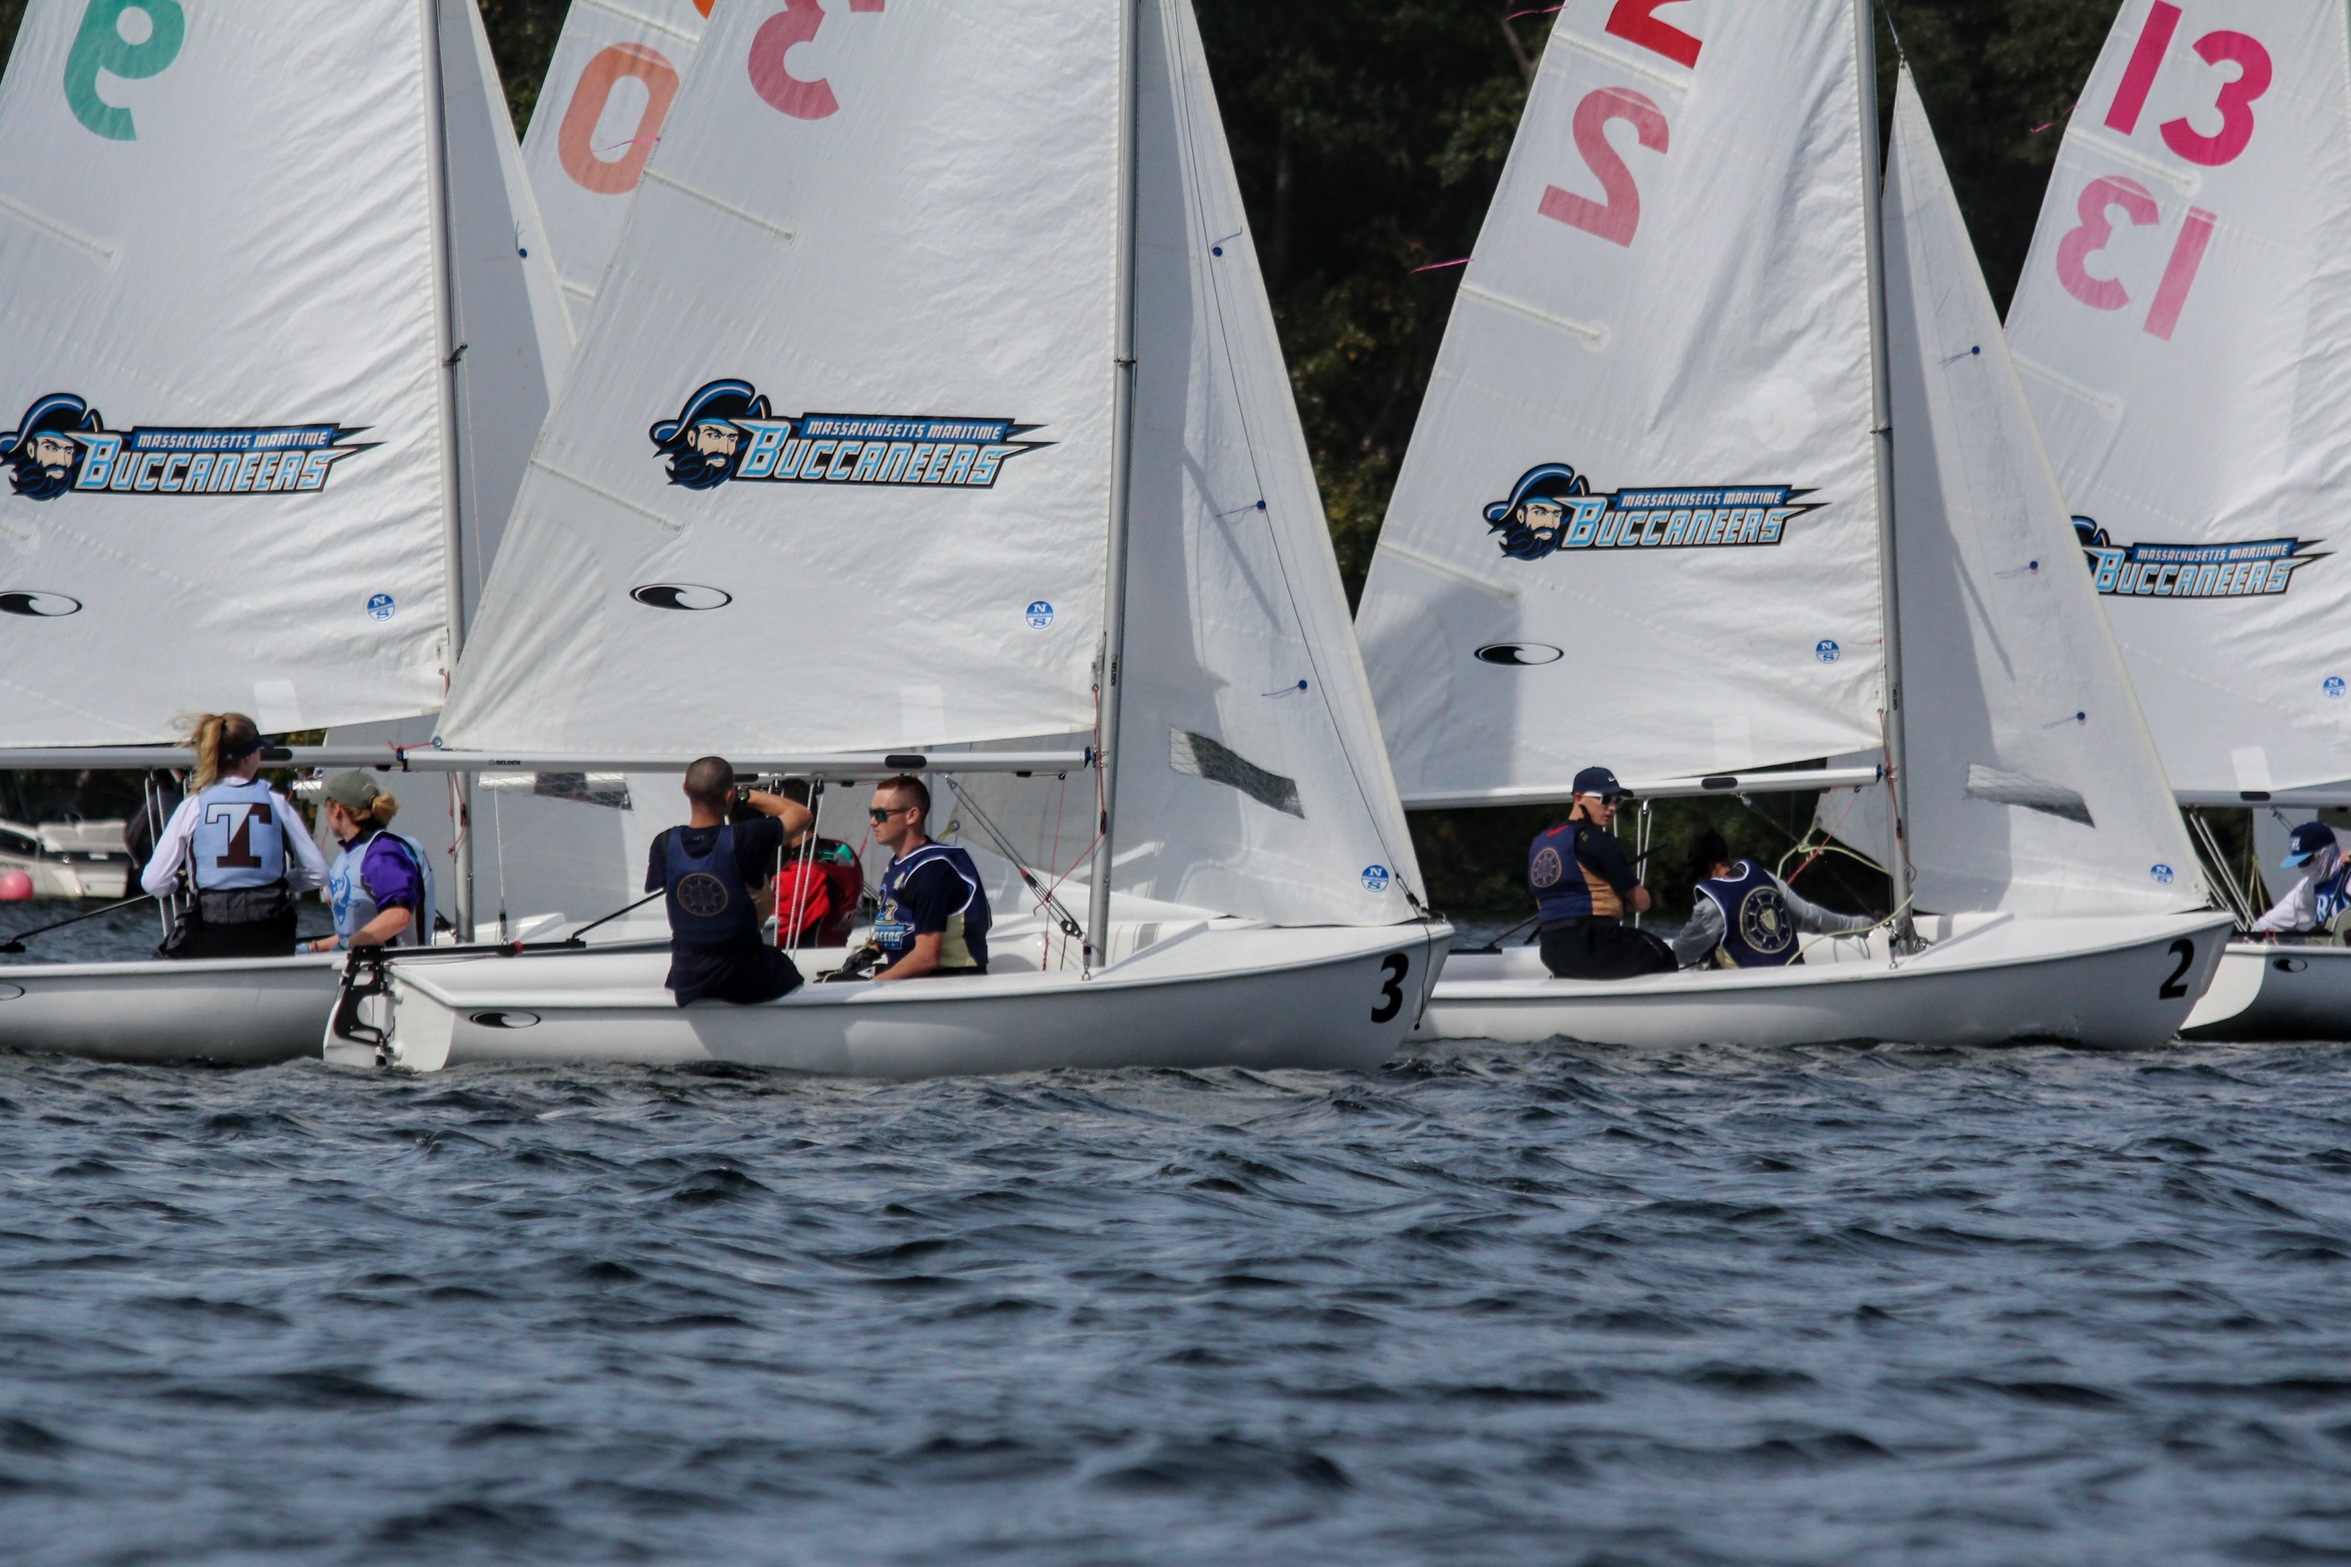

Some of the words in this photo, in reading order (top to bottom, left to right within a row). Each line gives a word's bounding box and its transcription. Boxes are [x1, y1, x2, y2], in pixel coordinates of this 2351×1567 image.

[2104, 0, 2272, 166] 13
[137, 433, 250, 449] MASSACHUSETTS
[253, 430, 327, 448] MARITIME
[729, 419, 1029, 484] BUCCANEERS
[808, 421, 925, 438] MASSACHUSETTS
[927, 424, 1001, 440] MARITIME
[64, 432, 358, 492] BUCCANEERS
[1553, 497, 1807, 547] BUCCANEERS
[1621, 493, 1720, 507] MASSACHUSETTS
[1723, 491, 1782, 505] MARITIME
[2082, 545, 2314, 595] BUCCANEERS
[2136, 549, 2226, 561] MASSACHUSETTS
[2228, 544, 2288, 559] MARITIME
[205, 802, 272, 869] T
[1371, 952, 1409, 1024] 3
[2159, 938, 2194, 1000] 2
